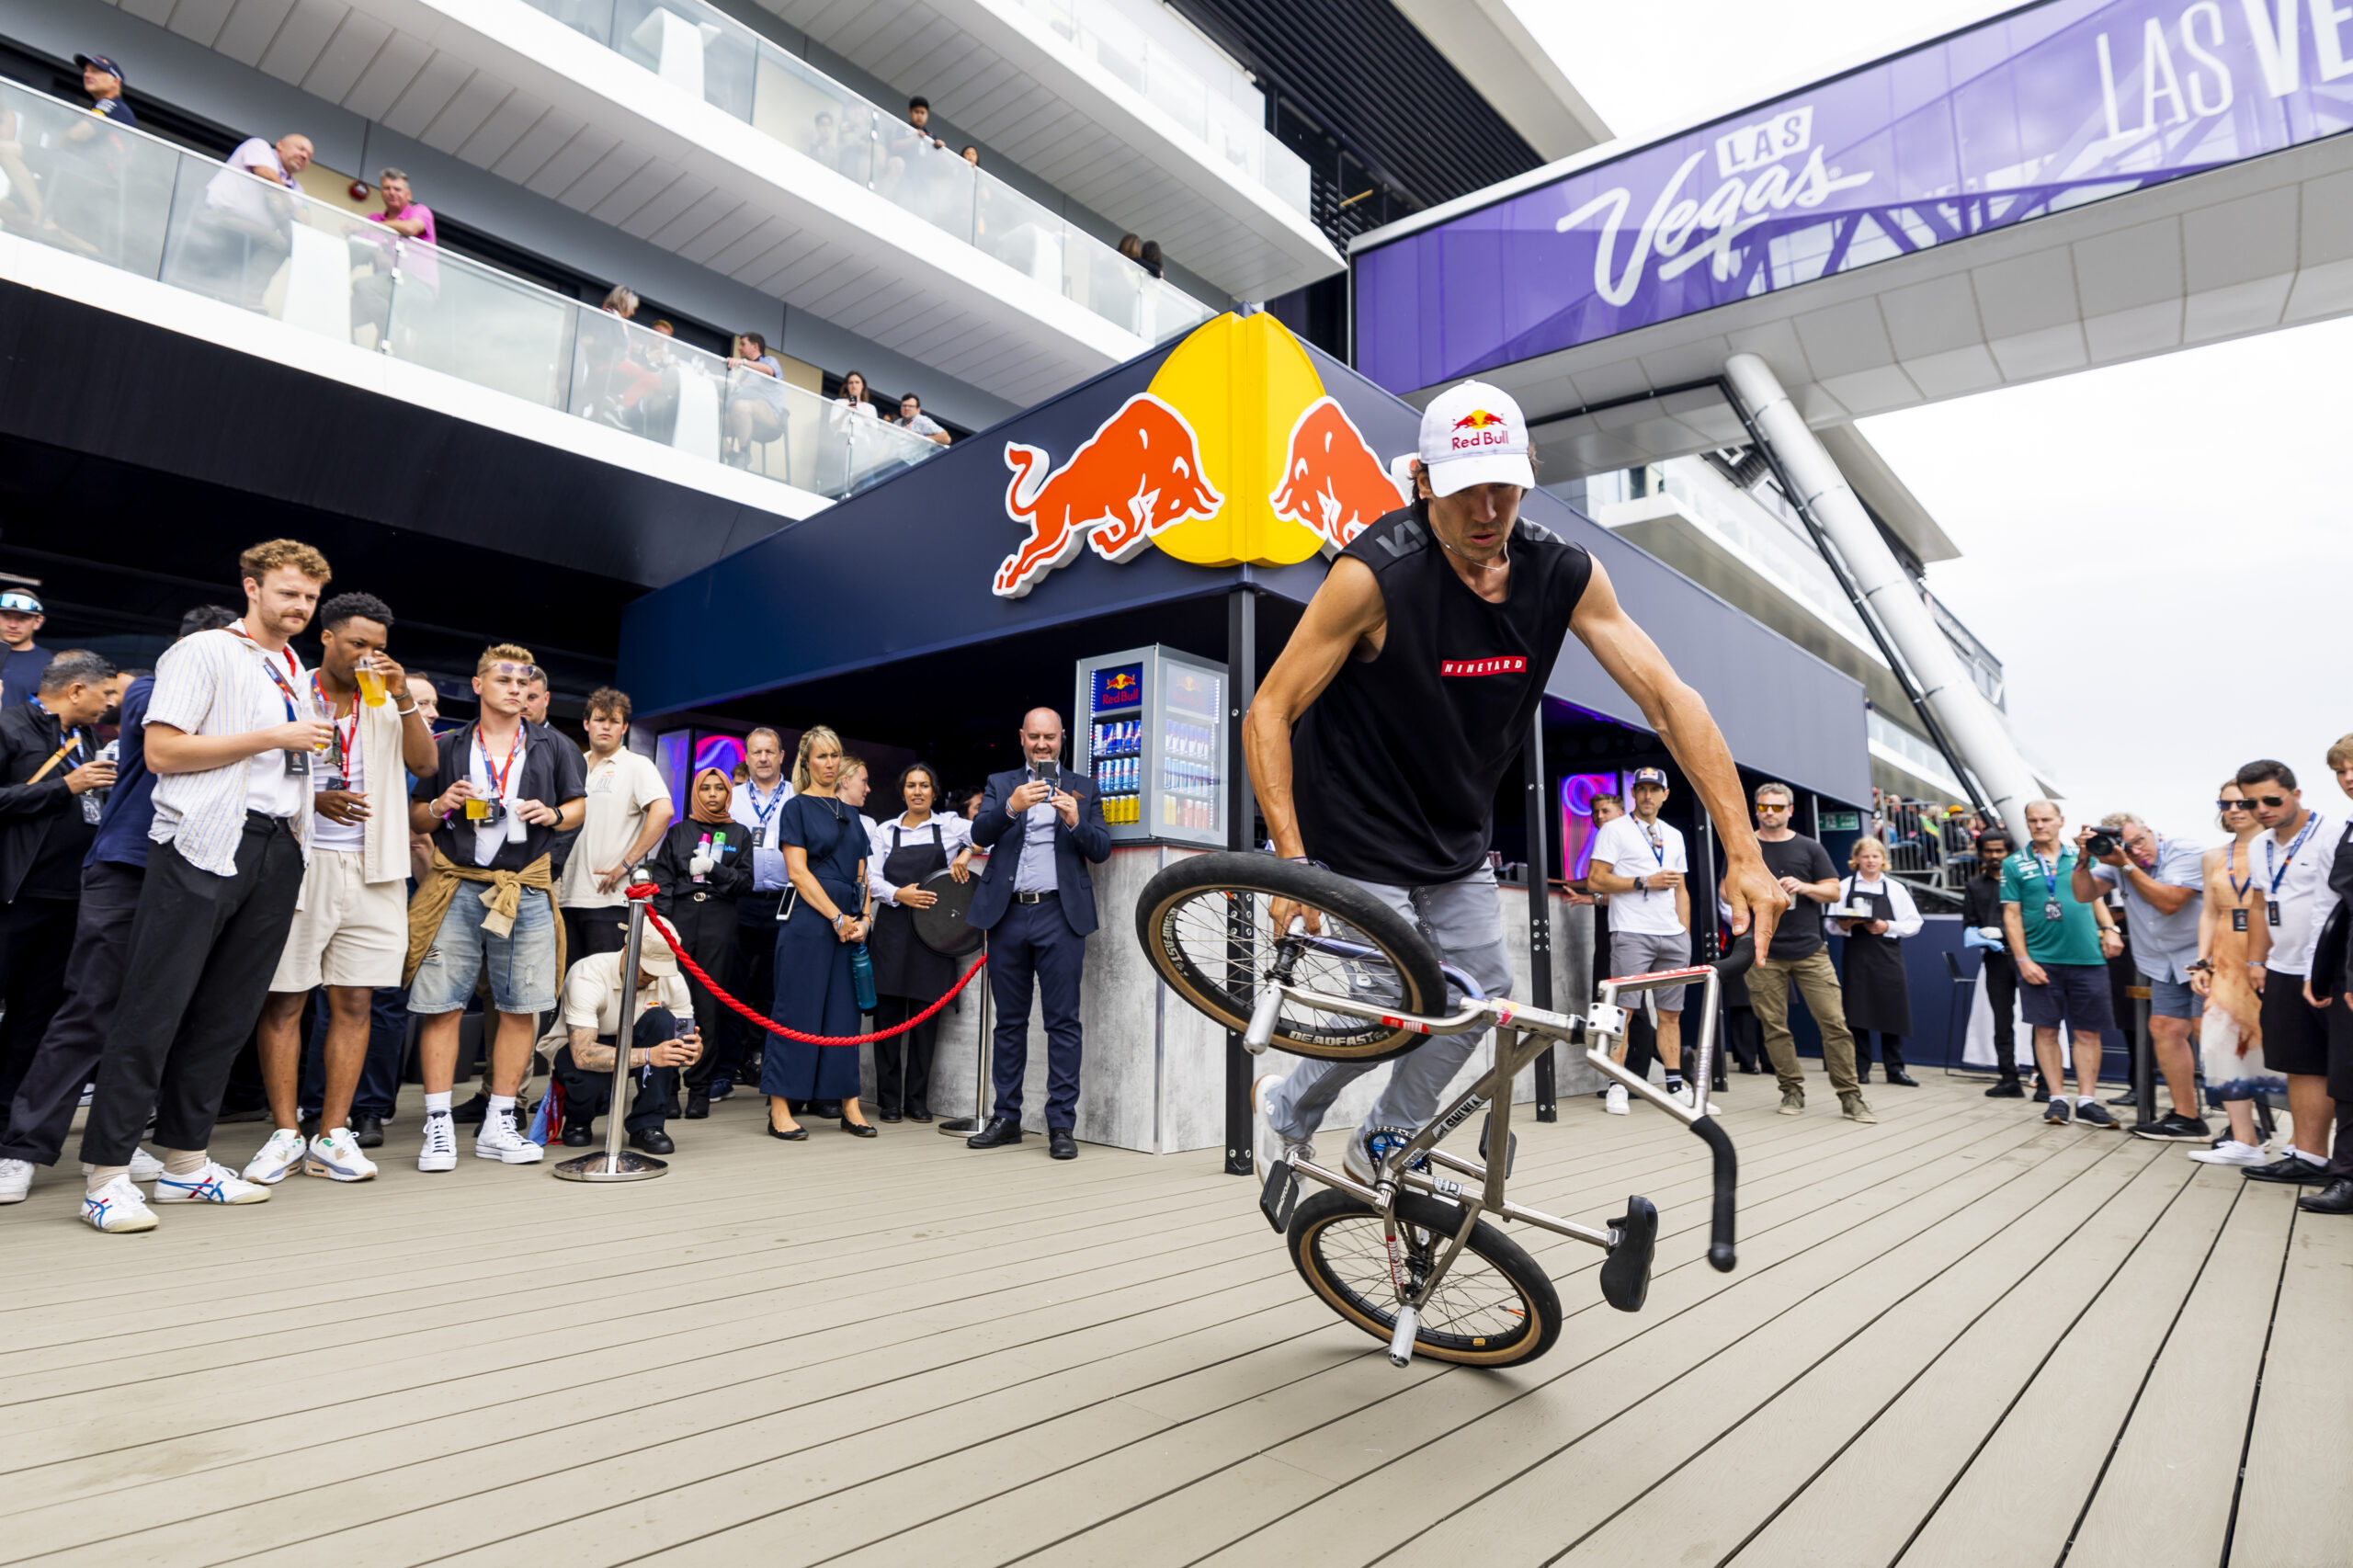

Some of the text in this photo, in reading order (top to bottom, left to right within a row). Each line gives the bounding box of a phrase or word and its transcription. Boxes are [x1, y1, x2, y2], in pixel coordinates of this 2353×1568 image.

[2096, 2, 2234, 139] LAS
[1727, 115, 1802, 168] LAS
[1555, 143, 1874, 307] Vegas
[1451, 430, 1509, 450] Red Bull
[1444, 660, 1523, 674] NINEYARD
[1102, 687, 1139, 705] Red Bull
[1289, 1030, 1374, 1047] DEADFAST
